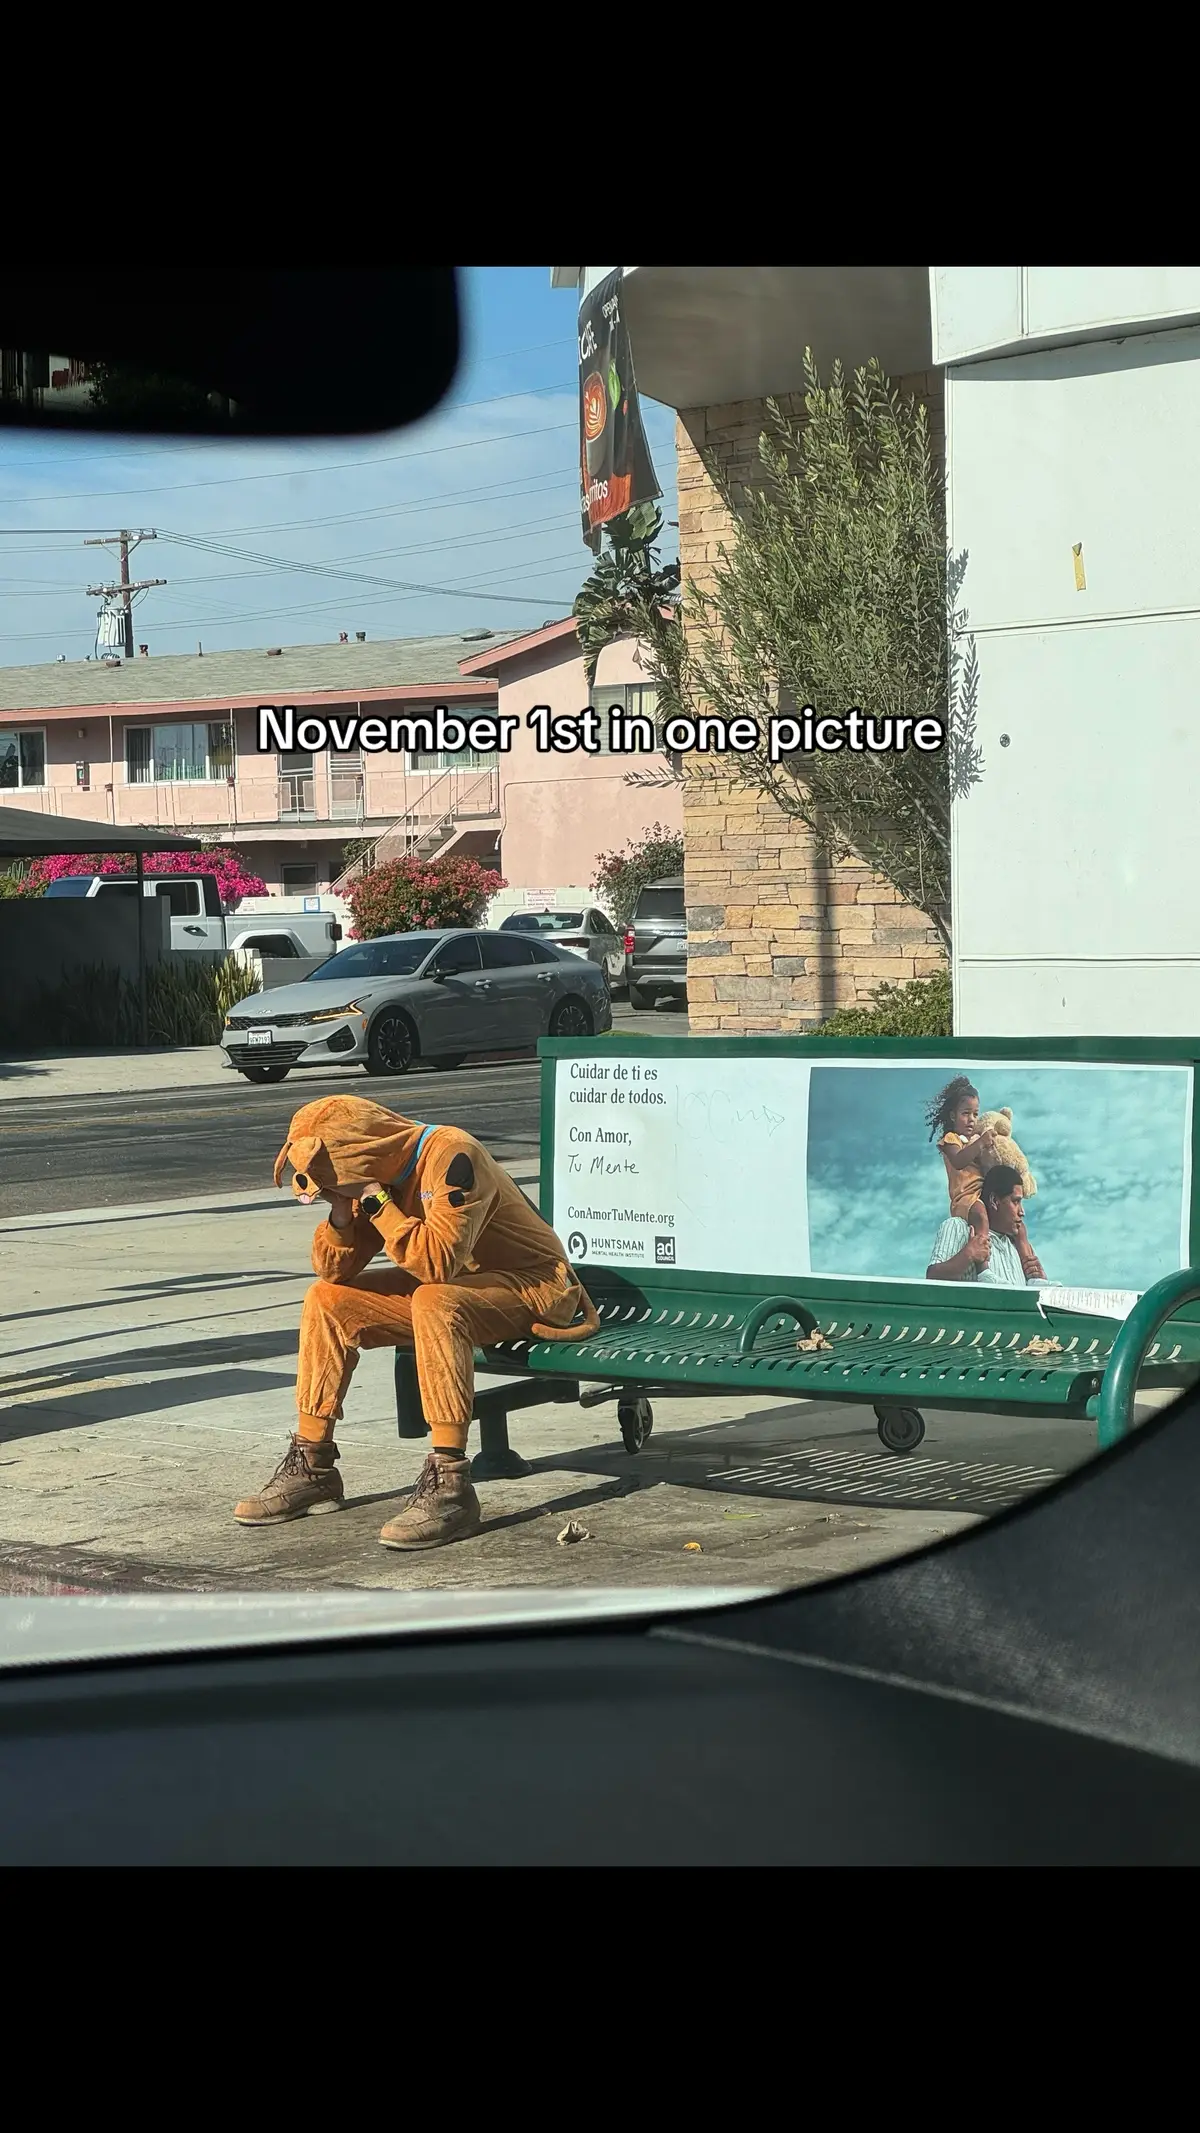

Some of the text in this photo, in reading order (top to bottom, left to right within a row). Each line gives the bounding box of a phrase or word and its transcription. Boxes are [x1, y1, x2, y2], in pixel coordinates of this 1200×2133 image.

[570, 1063, 658, 1081] Cuidar de ti es
[569, 1087, 667, 1104] cuidar de todos.
[569, 1126, 632, 1146] Con Amor,
[568, 1154, 640, 1175] Tu Mente
[567, 1206, 675, 1228] ConAmorTuMente.org
[591, 1238, 644, 1251] HUNTSMAN
[656, 1239, 674, 1256] ad
